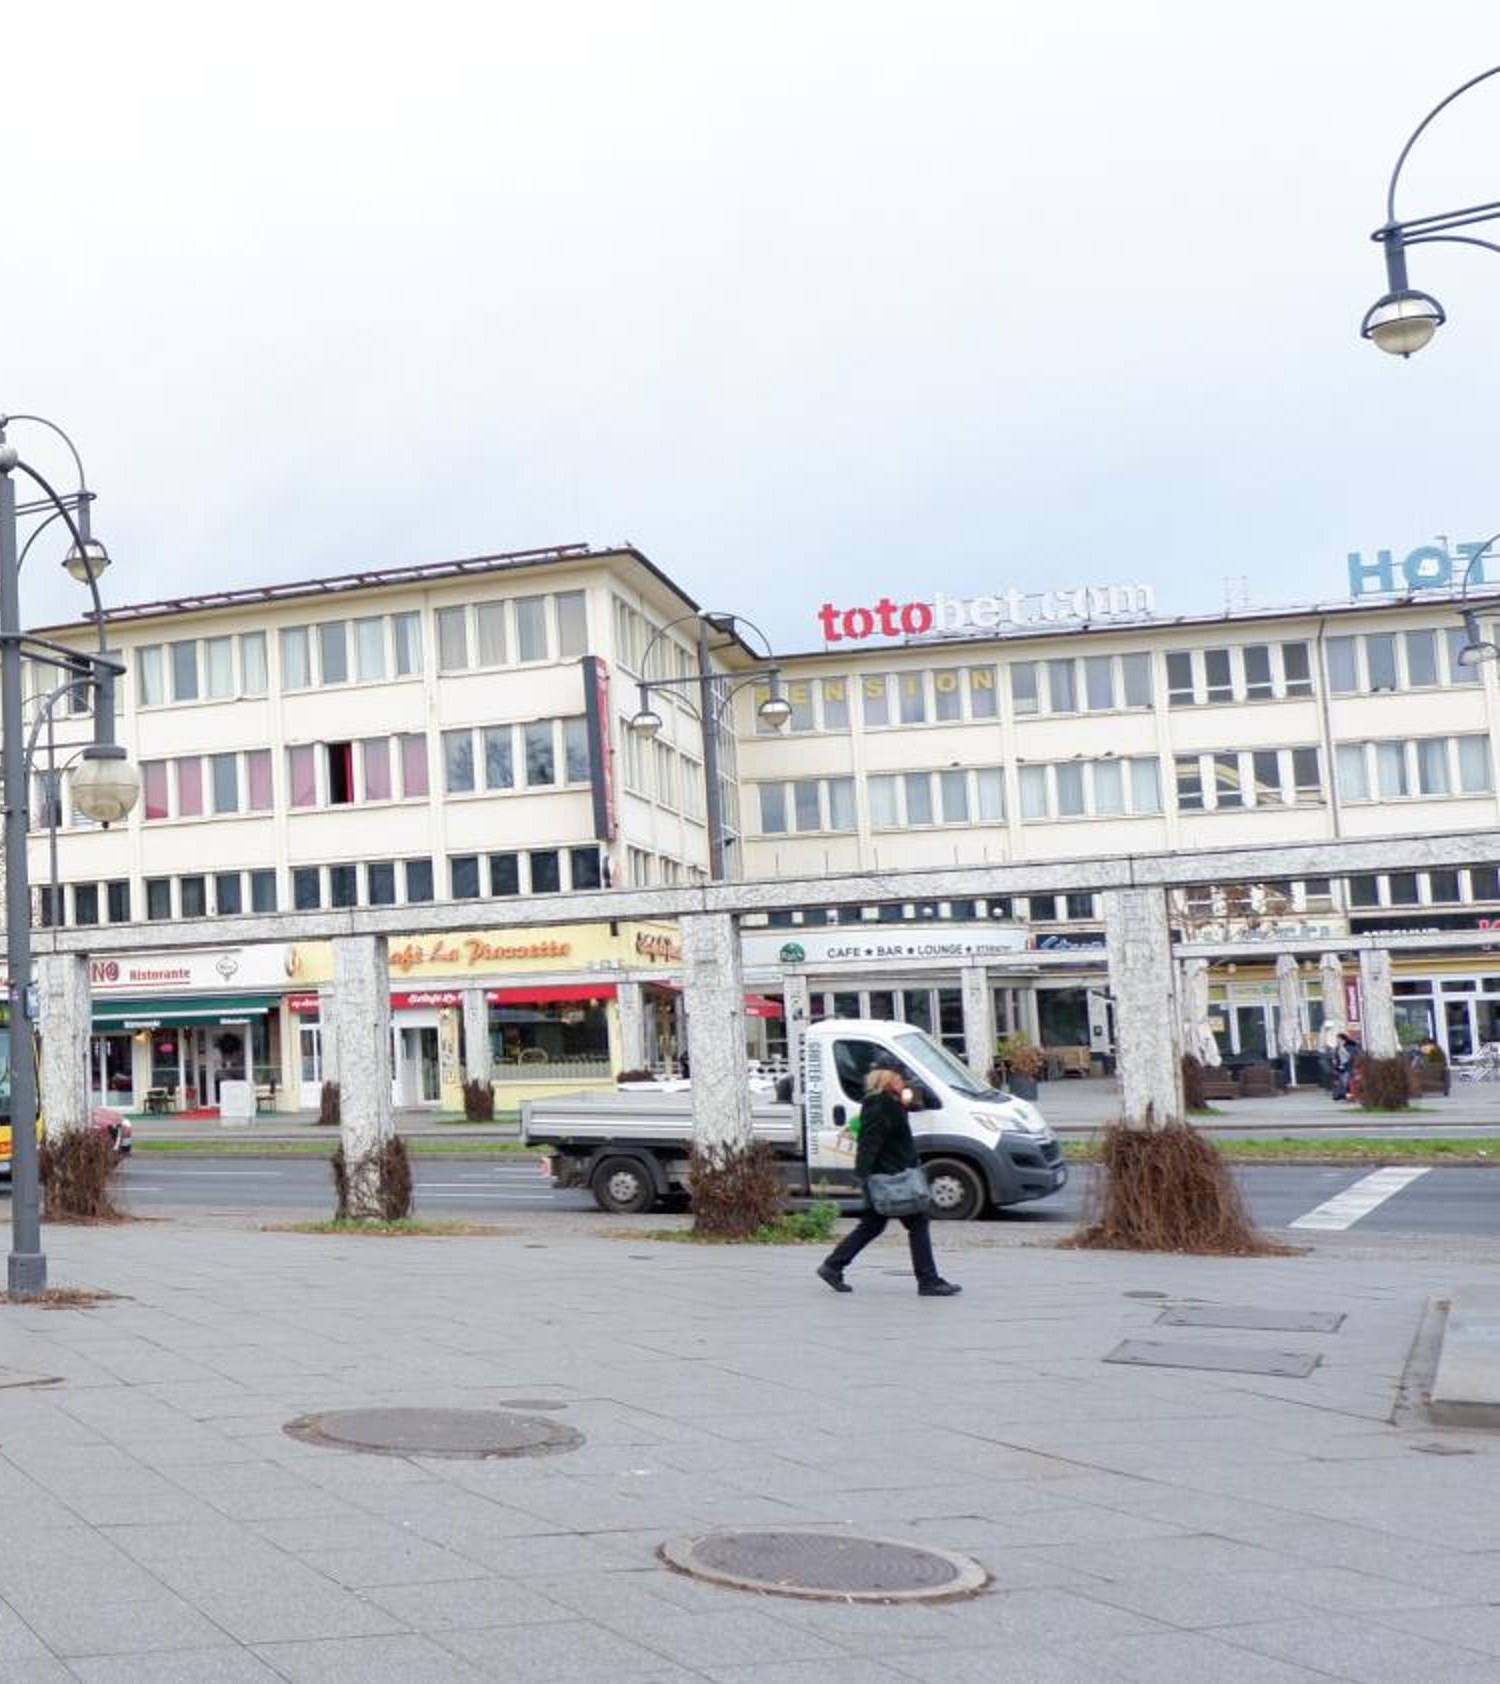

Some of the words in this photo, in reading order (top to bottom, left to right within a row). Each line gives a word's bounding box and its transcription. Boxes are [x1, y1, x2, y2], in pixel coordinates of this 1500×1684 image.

[827, 947, 861, 959] CAFE
[877, 945, 904, 957] BAR
[917, 943, 963, 955] LOUNGE
[129, 968, 191, 981] Ristorante
